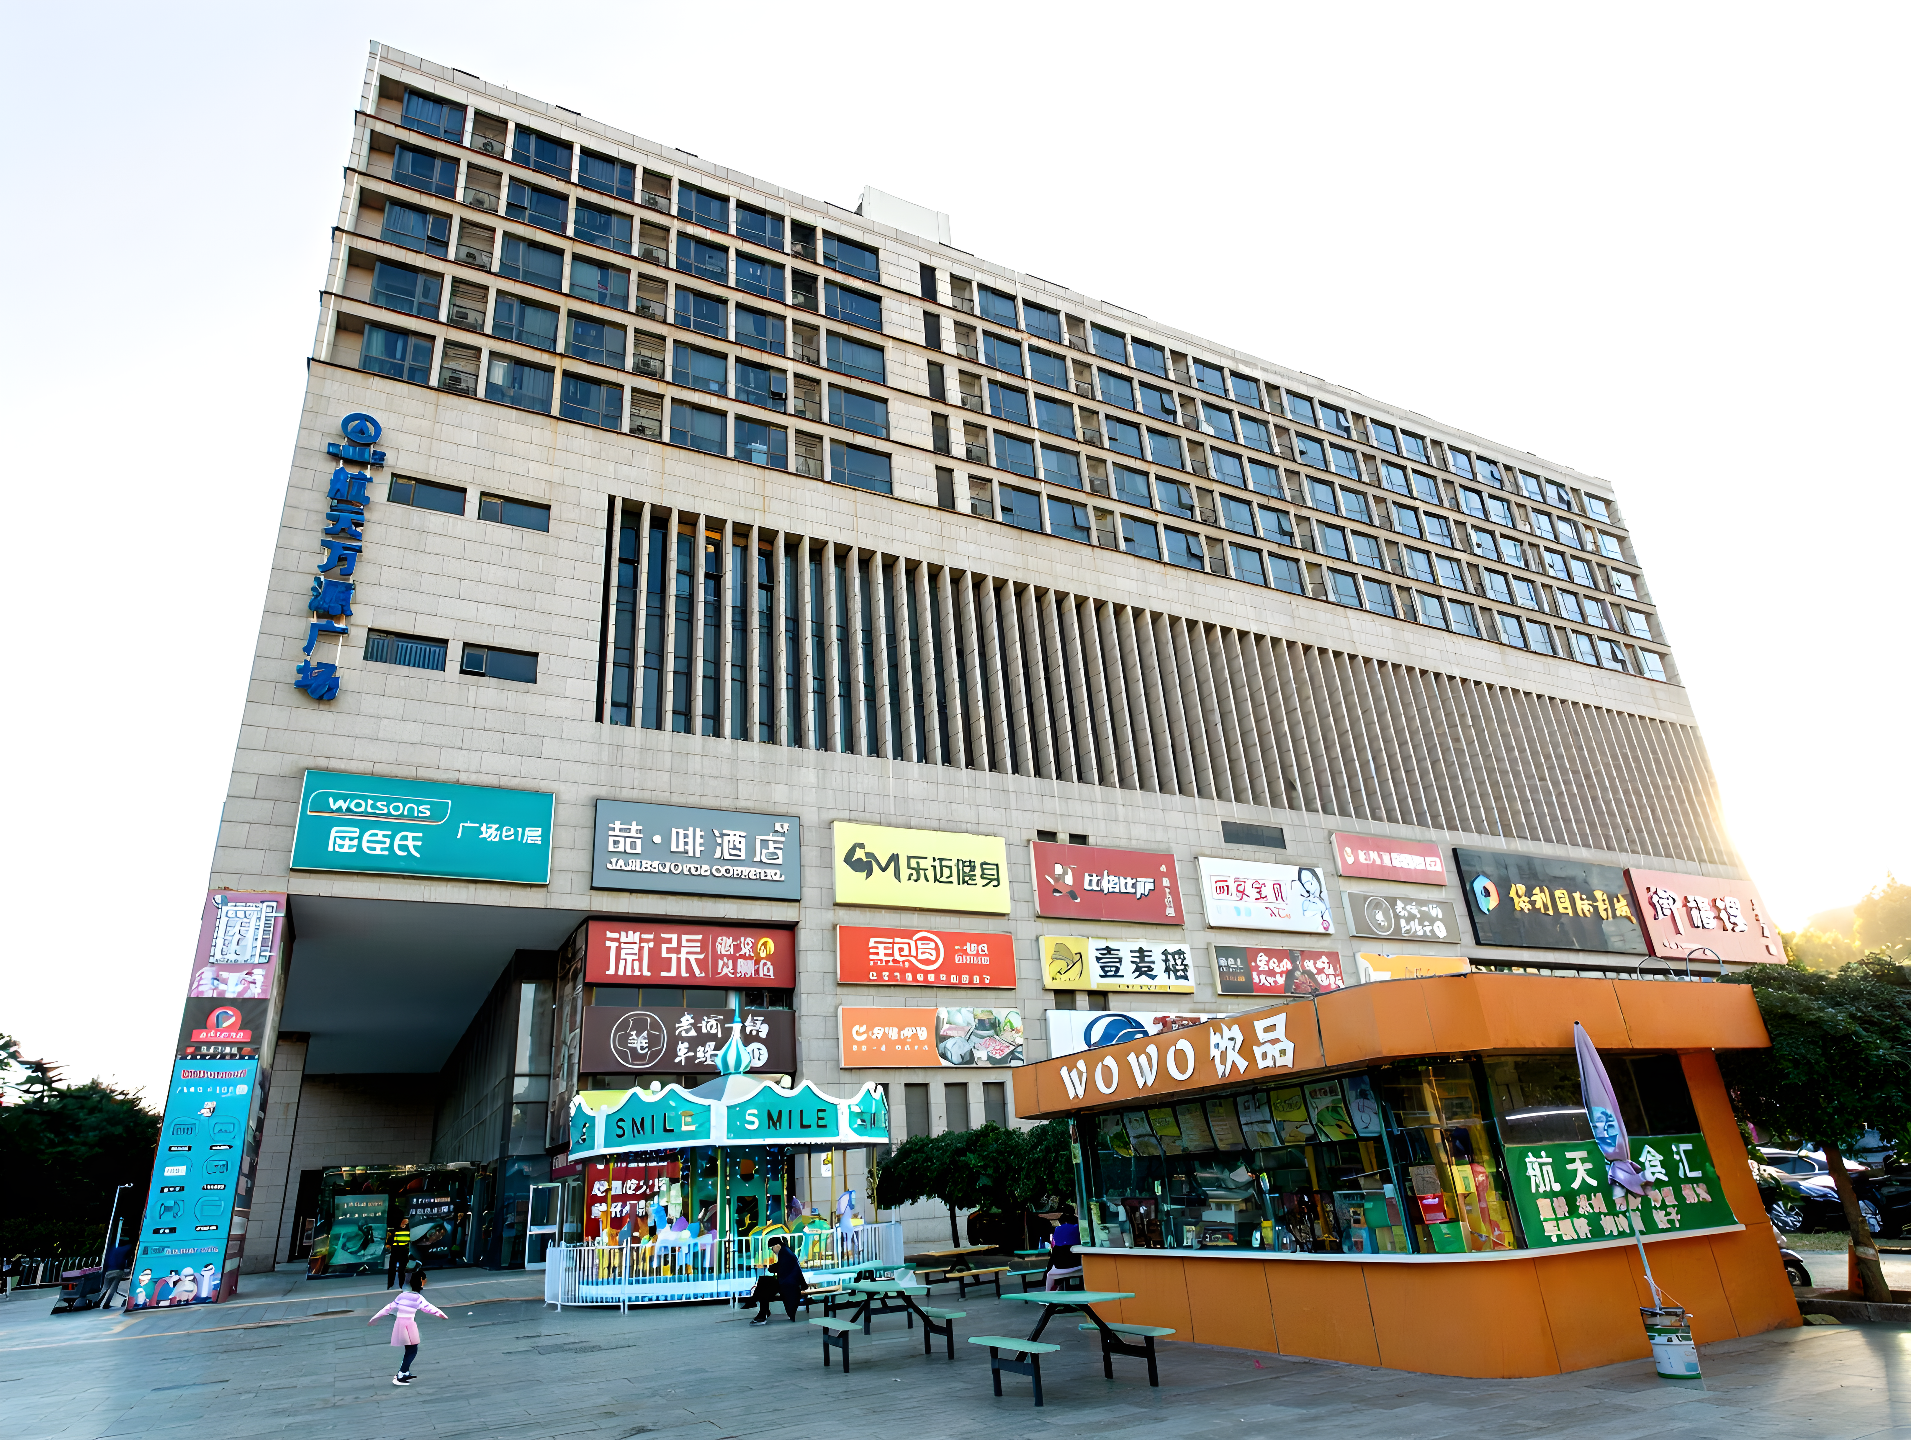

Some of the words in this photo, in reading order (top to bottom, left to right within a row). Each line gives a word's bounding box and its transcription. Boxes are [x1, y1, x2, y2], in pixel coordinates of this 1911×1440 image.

[329, 796, 431, 817] watsons
[328, 826, 423, 857] 屈臣氏
[906, 855, 1001, 888] 乐迈健身
[1060, 1038, 1195, 1101] WOWO
[1209, 1012, 1295, 1079] 饮品
[615, 1110, 697, 1139] SMILE
[744, 1108, 828, 1131] SMILE
[1525, 1143, 1703, 1194] 航天食汇
